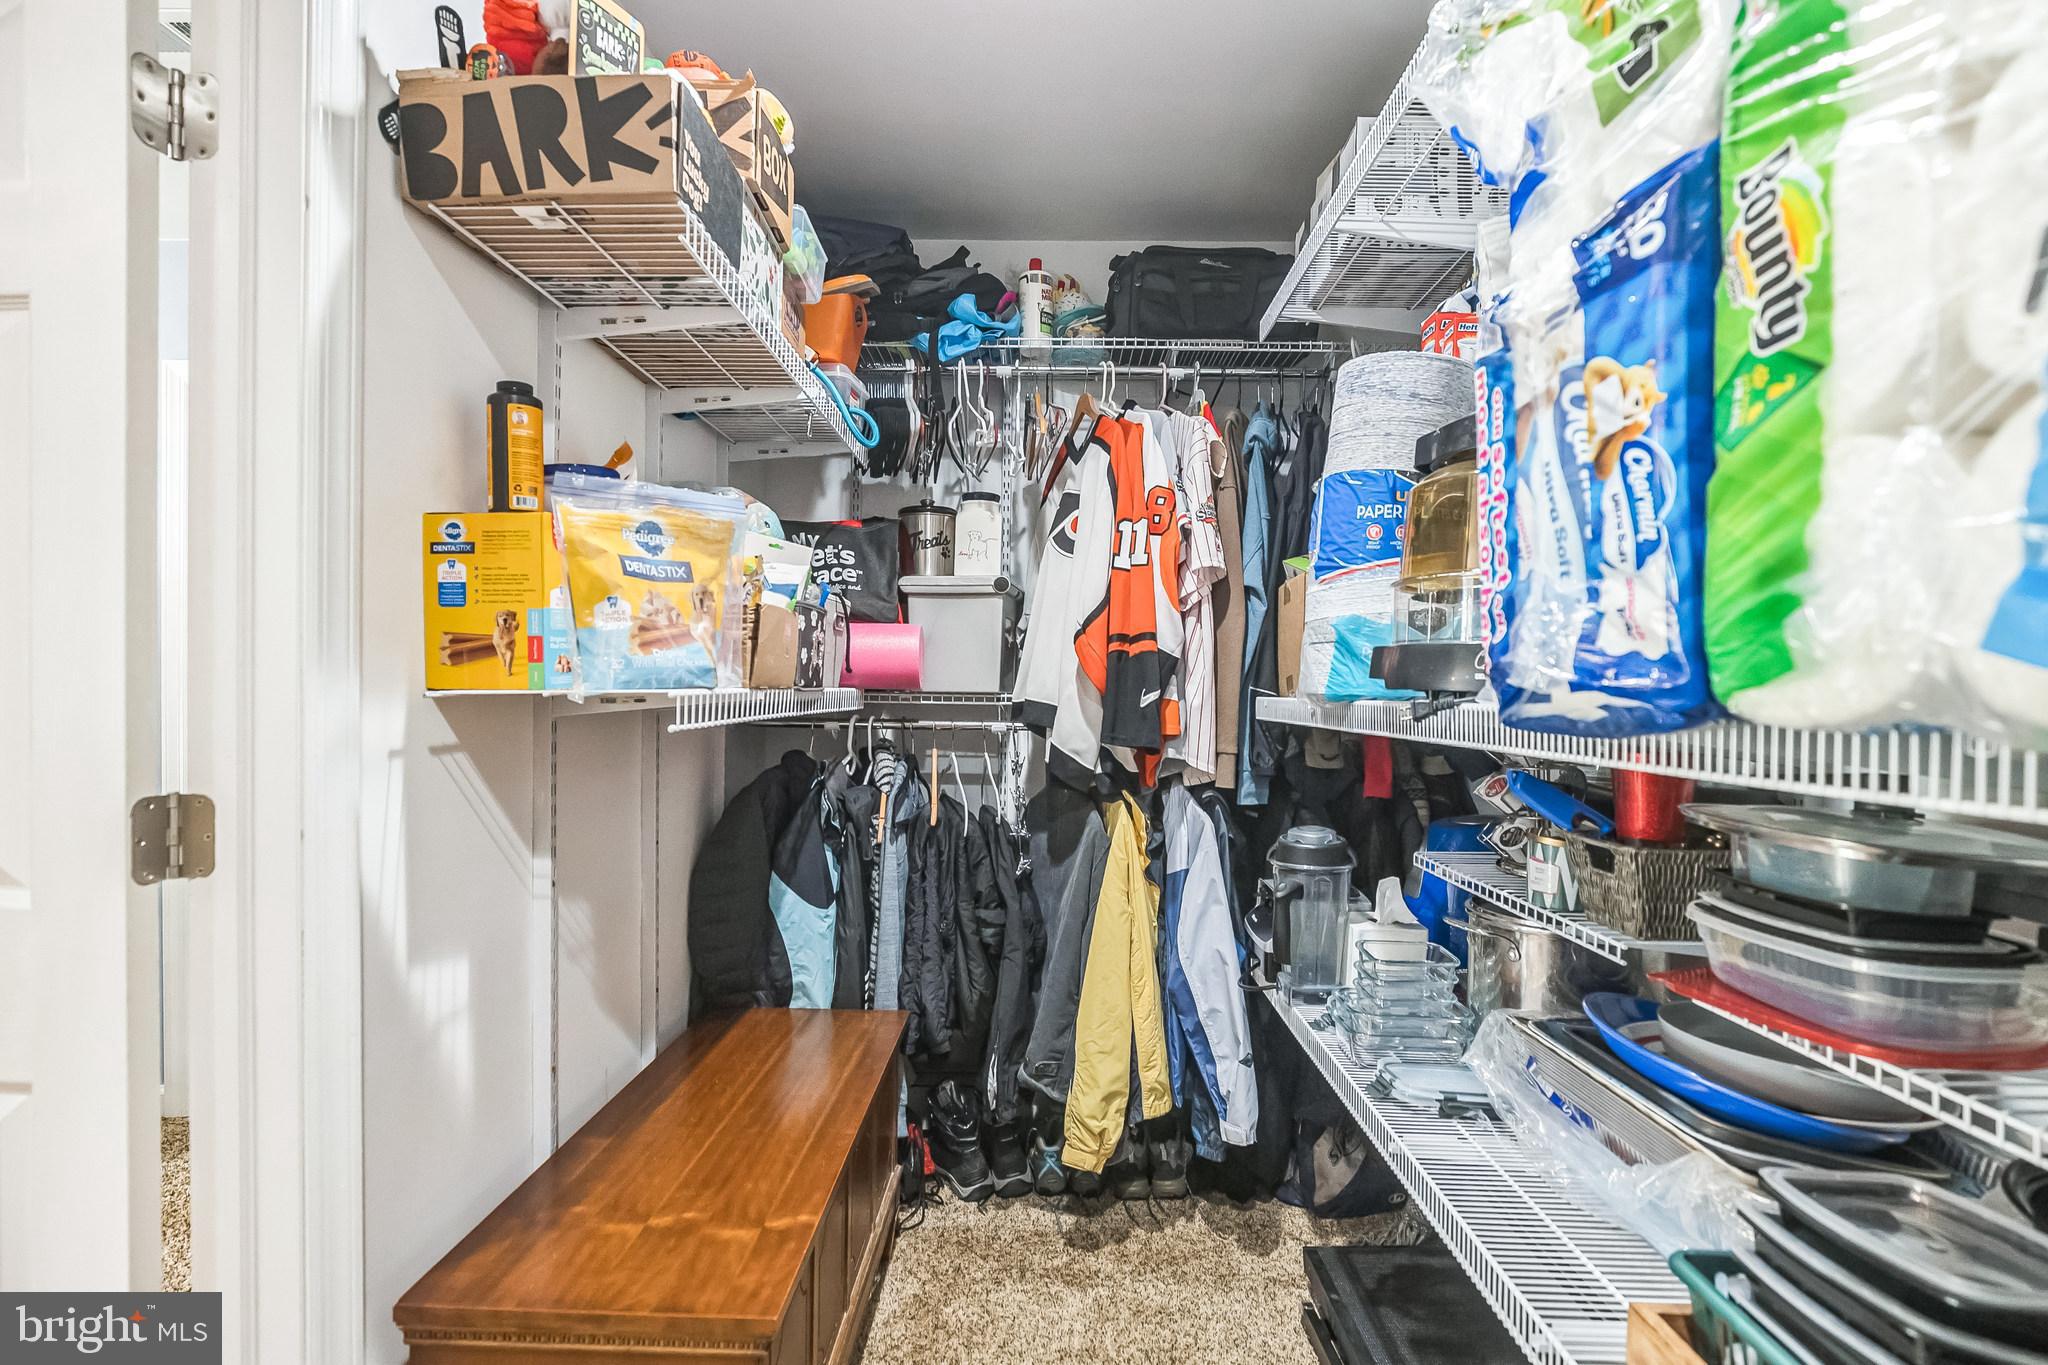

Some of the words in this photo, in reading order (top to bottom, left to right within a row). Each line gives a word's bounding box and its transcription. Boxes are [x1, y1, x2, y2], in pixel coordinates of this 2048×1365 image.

[400, 77, 660, 200] BARK
[684, 129, 701, 167] You
[683, 149, 709, 203] Lucky
[763, 134, 787, 196] BOX
[1739, 147, 1804, 350] Bounty
[1477, 371, 1489, 464] most
[1146, 485, 1176, 536] 8
[1357, 504, 1402, 519] PAPER
[1623, 447, 1659, 543] Charmin
[433, 544, 471, 552] DENTASTIX
[622, 528, 675, 546] Pedigree
[811, 544, 856, 567] et's
[910, 530, 950, 551] Treats
[1112, 517, 1149, 571] 11
[1555, 527, 1571, 579] Soft
[625, 560, 687, 578] DENTASTIX
[813, 566, 857, 584] ace
